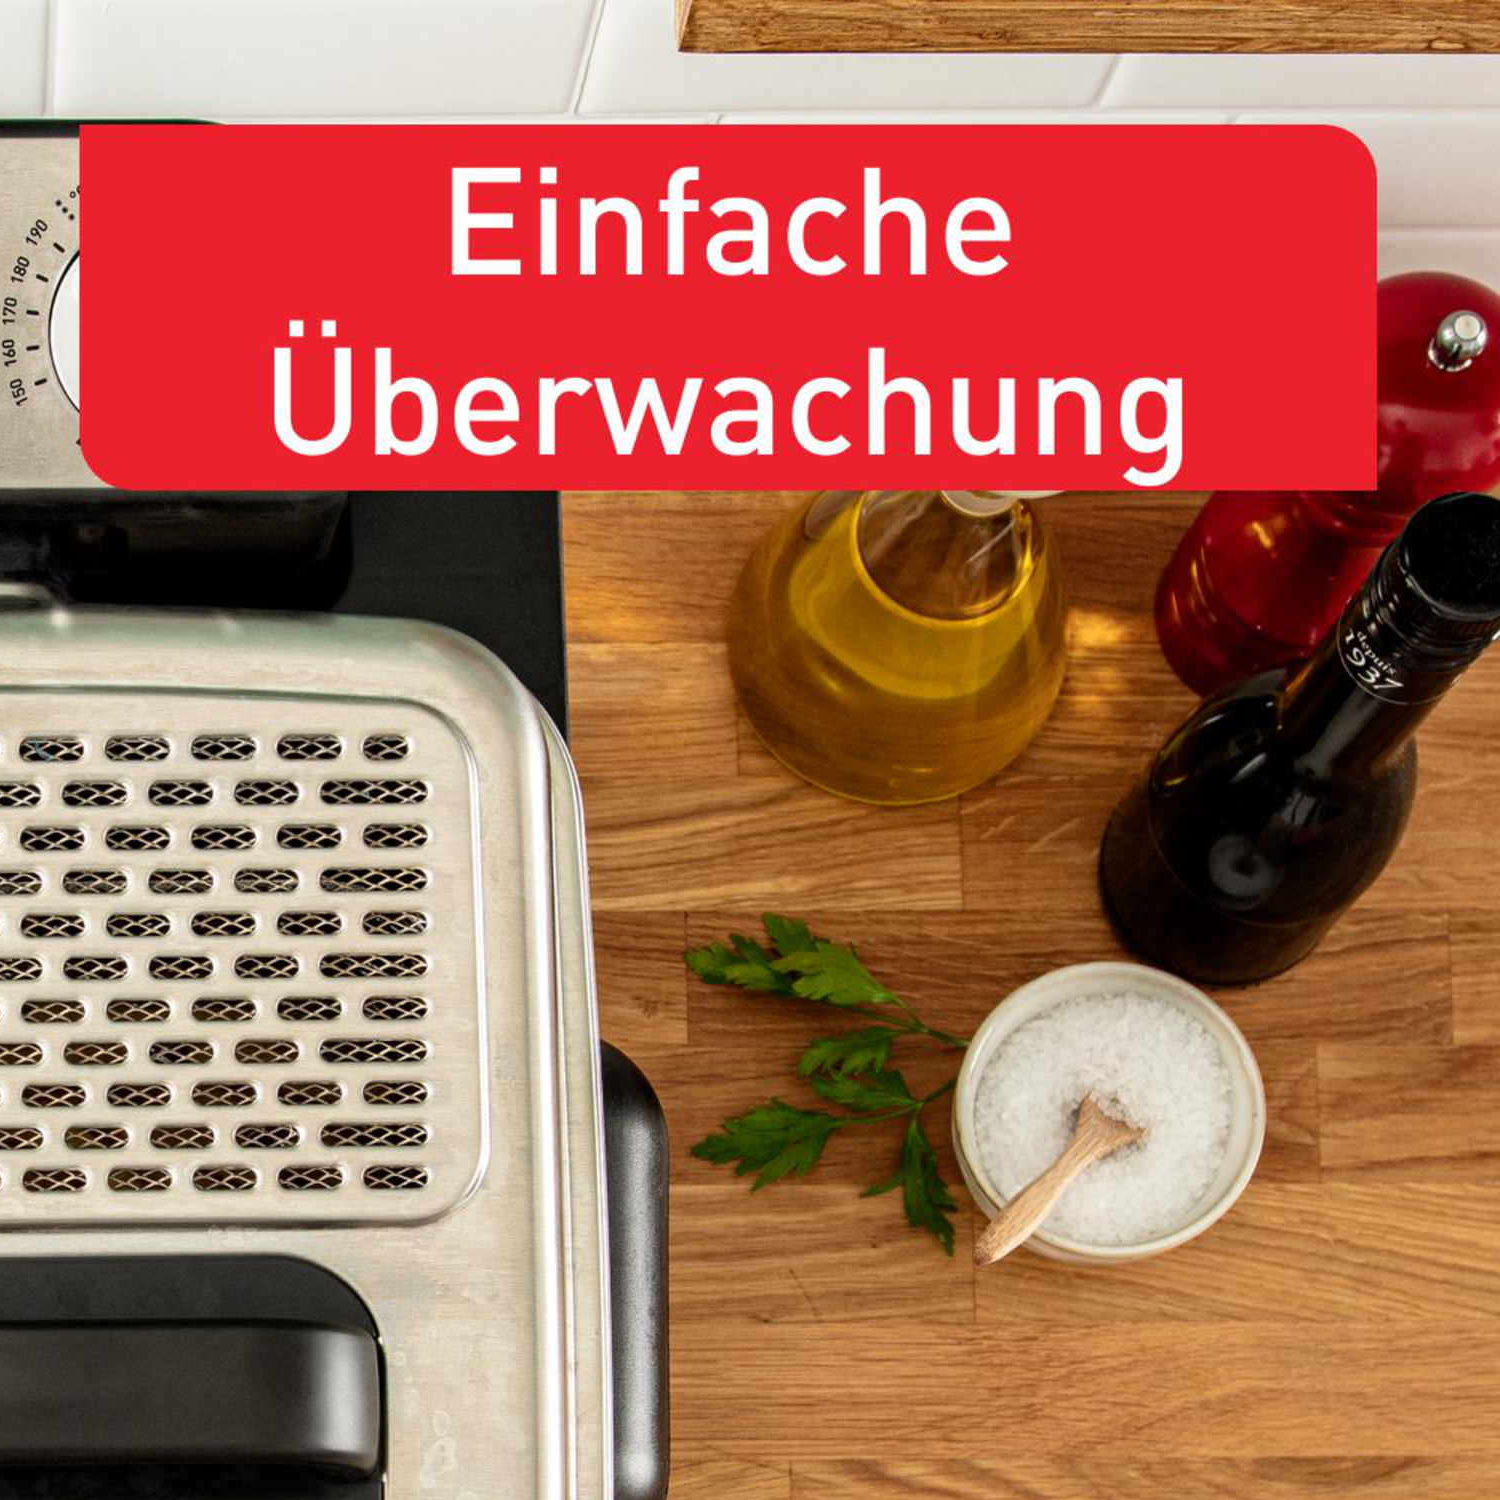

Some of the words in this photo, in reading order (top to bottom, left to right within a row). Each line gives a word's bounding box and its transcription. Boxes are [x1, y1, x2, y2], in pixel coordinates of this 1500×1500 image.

[25, 218, 49, 246] 190
[10, 255, 31, 284] 180
[1, 296, 18, 325] 170
[1, 338, 18, 368] 160
[9, 377, 29, 407] 150
[1344, 627, 1404, 690] 1937
[1356, 630, 1397, 676] depuis
